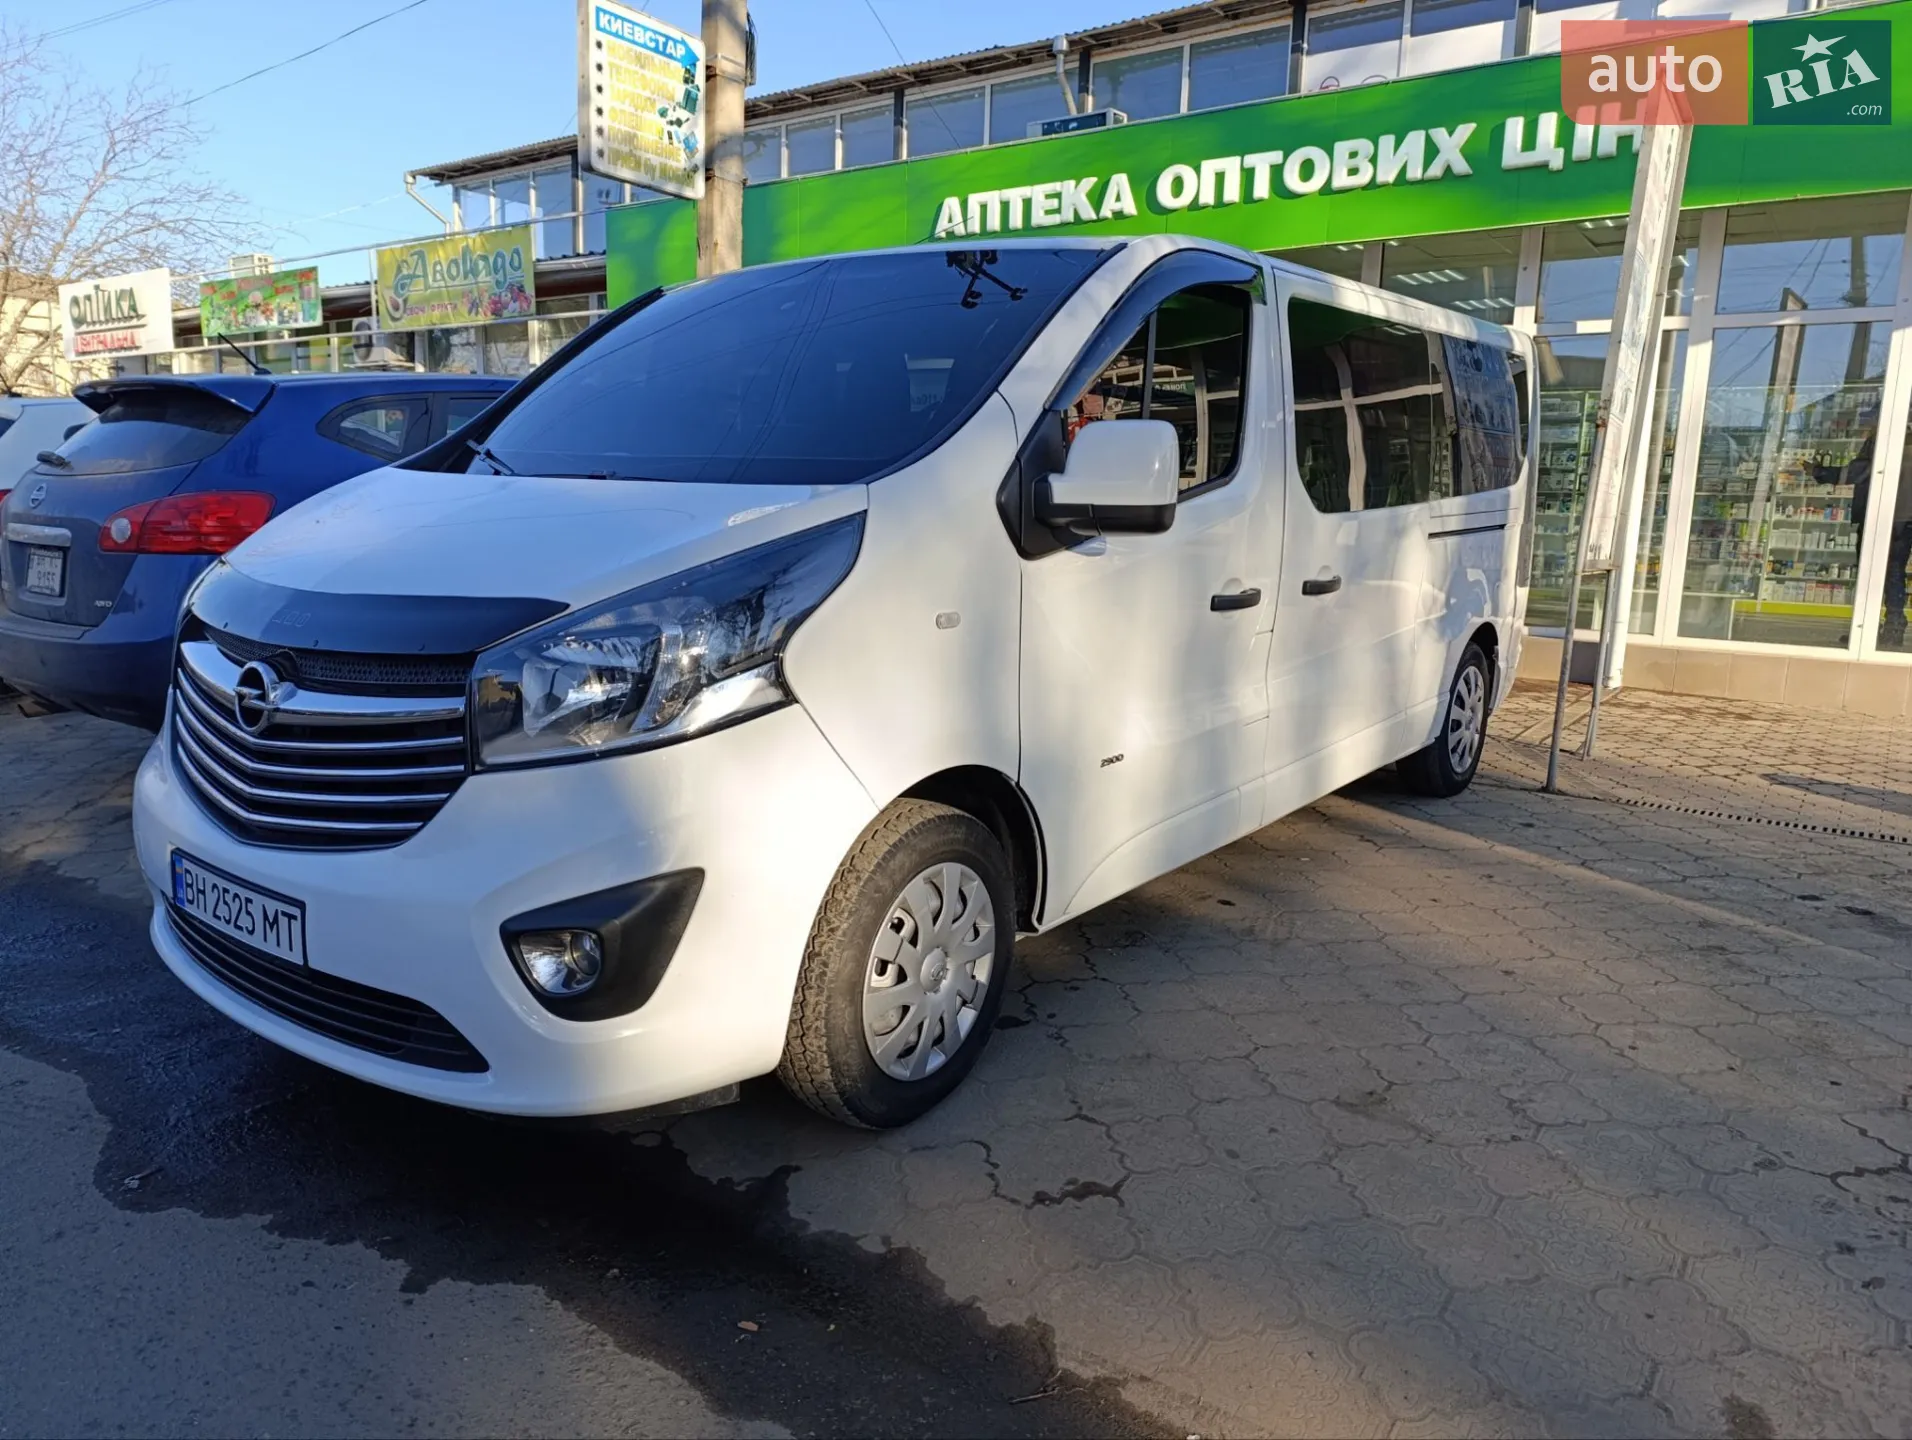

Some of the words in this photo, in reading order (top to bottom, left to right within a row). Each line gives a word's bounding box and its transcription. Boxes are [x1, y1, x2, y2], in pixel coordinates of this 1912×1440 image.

[599, 11, 686, 60] КИЕВСТАР
[935, 172, 1138, 239] АПТЕКА
[1155, 122, 1478, 211] ОПТОВИХ
[69, 284, 139, 329] ОПТИКА
[184, 867, 207, 914] BH
[211, 882, 255, 936] 2525
[262, 903, 298, 952] MT
